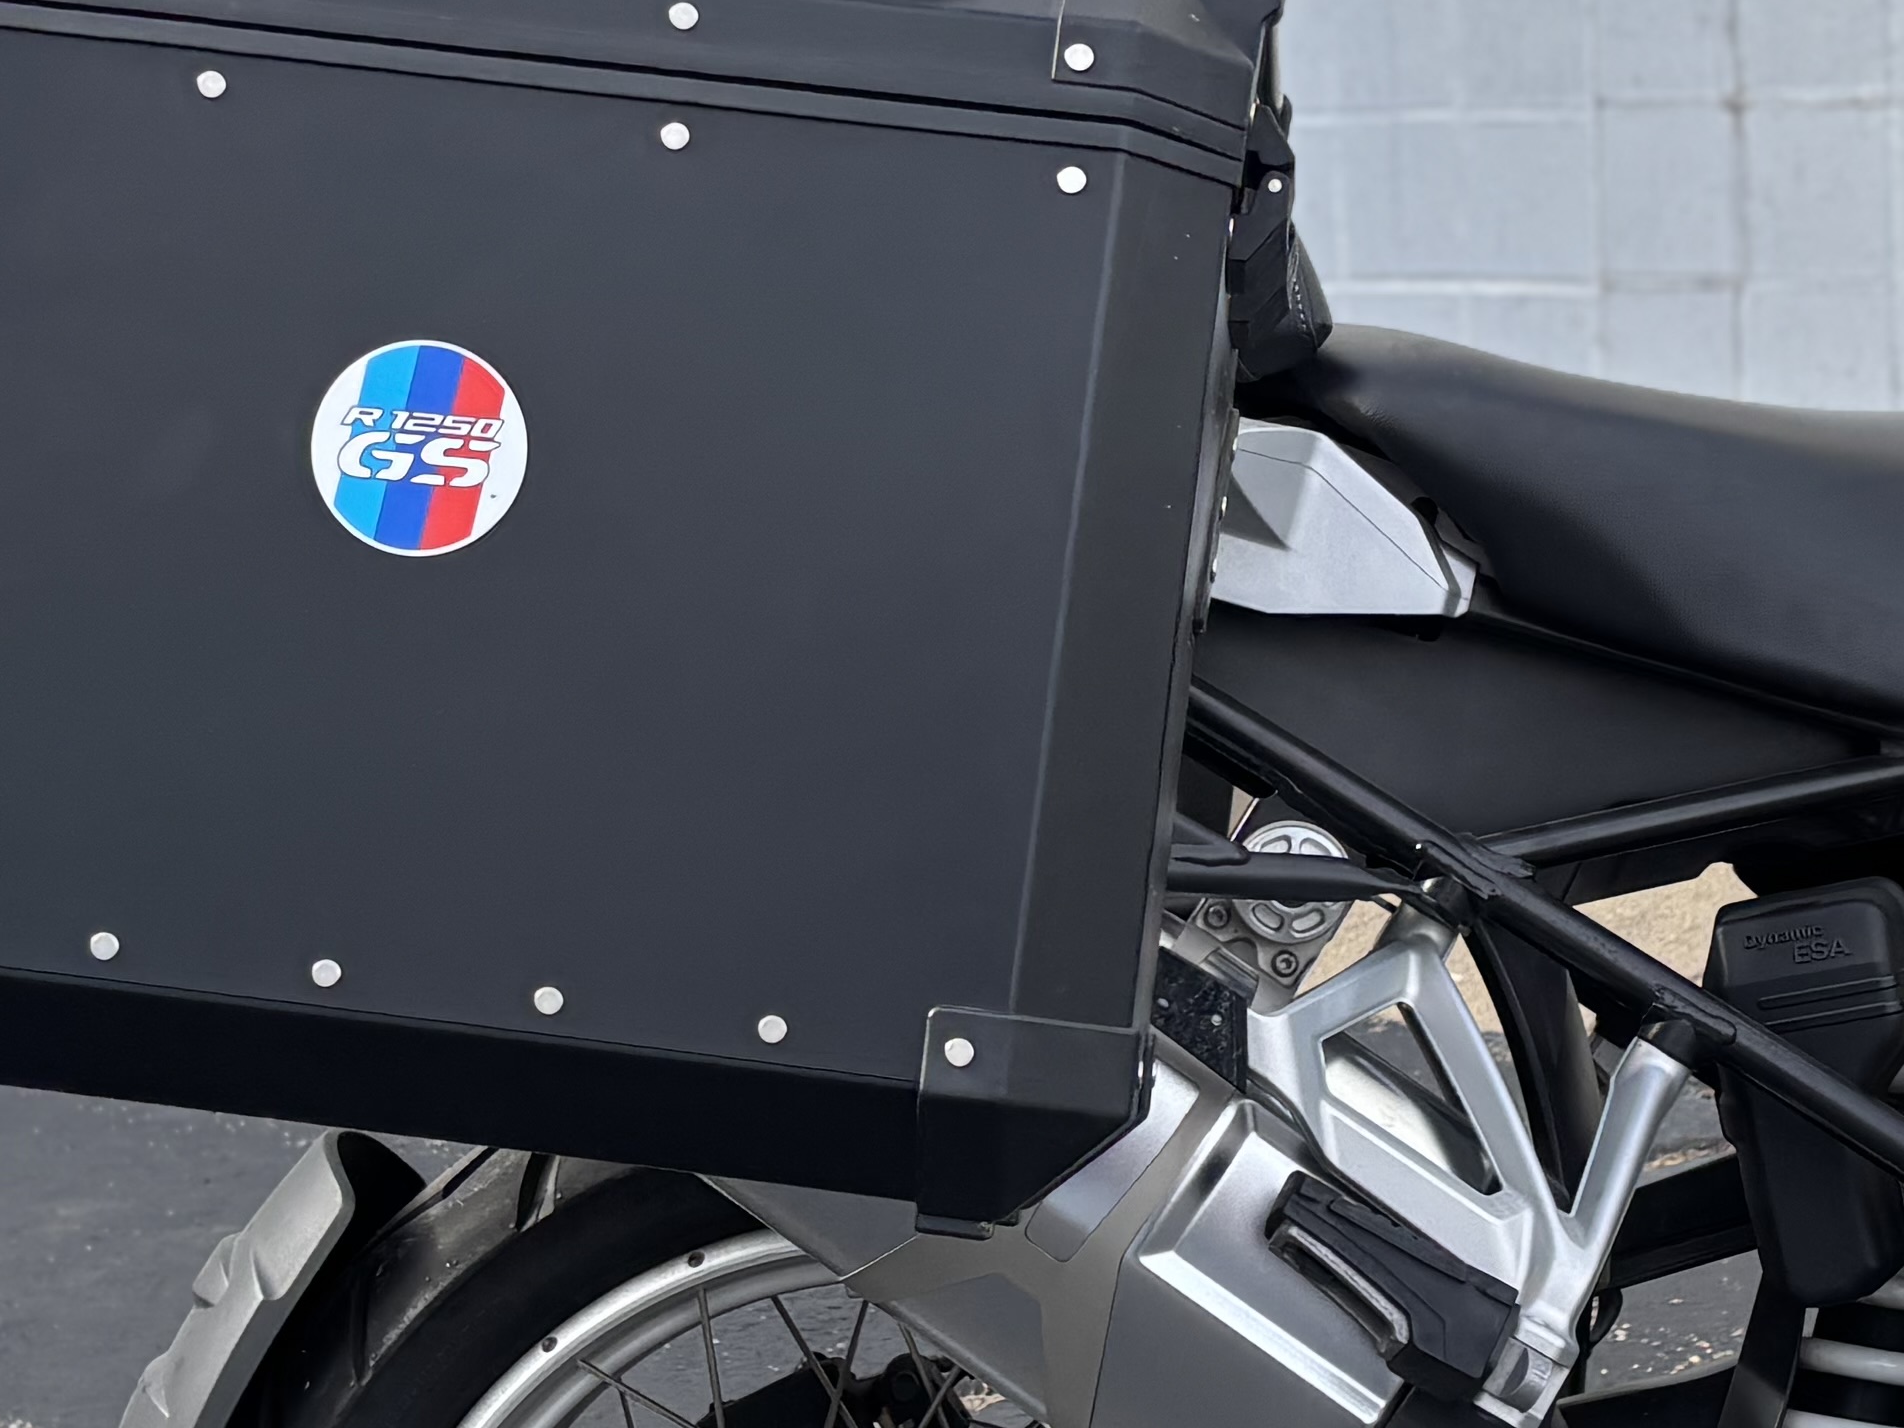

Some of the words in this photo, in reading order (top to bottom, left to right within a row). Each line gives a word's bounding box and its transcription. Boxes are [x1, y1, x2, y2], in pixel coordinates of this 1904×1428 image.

[341, 405, 384, 427] R
[390, 410, 505, 439] 1250
[337, 431, 502, 488] GS
[1743, 925, 1824, 951] Dynamic
[1793, 939, 1853, 965] ESA
